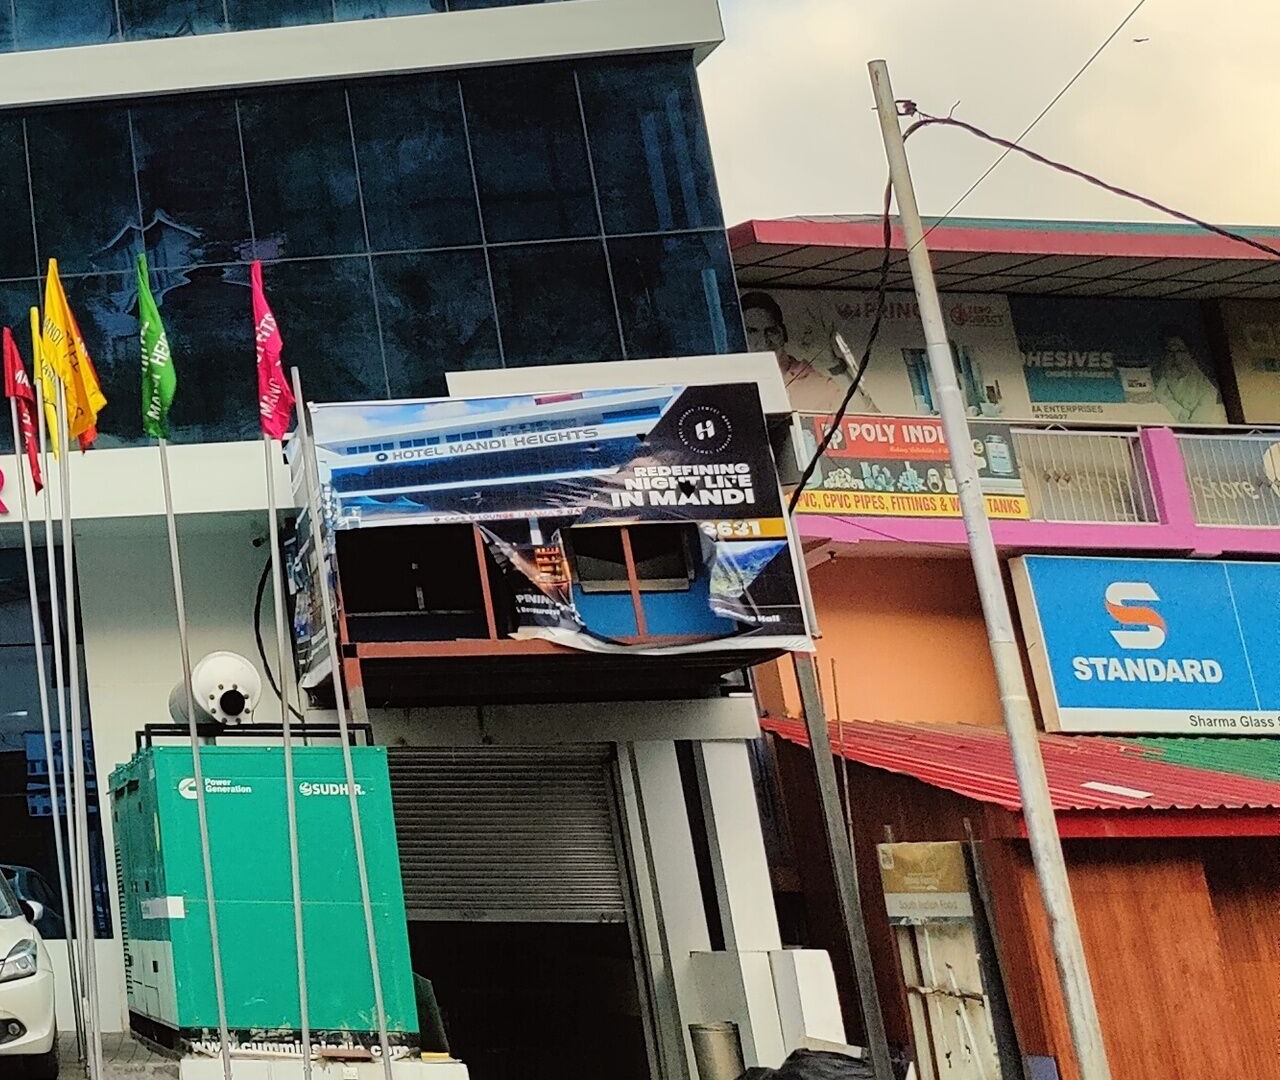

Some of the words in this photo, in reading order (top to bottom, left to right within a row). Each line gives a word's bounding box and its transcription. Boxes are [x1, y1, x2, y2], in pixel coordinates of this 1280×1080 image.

[1044, 405, 1104, 414] ENTERPRISES
[847, 423, 896, 444] POLY
[903, 425, 946, 444] INDI
[392, 448, 444, 461] HOTEL
[449, 438, 507, 454] MANDI
[513, 427, 599, 446] HEIGHTS
[633, 463, 750, 478] REDEFINING
[624, 476, 700, 491] NIGHT
[610, 491, 645, 508] IN
[649, 488, 755, 507] MANDI
[823, 494, 851, 509] CPVC
[853, 495, 889, 512] PIPES,
[891, 496, 937, 511] FITTINGS
[939, 498, 948, 511] &
[989, 499, 1022, 514] TANKS
[1071, 655, 1224, 684] STANDARD
[1189, 714, 1237, 727] Sharma
[1239, 715, 1275, 728] Glass
[204, 778, 232, 786] Power
[205, 785, 252, 794] Generation
